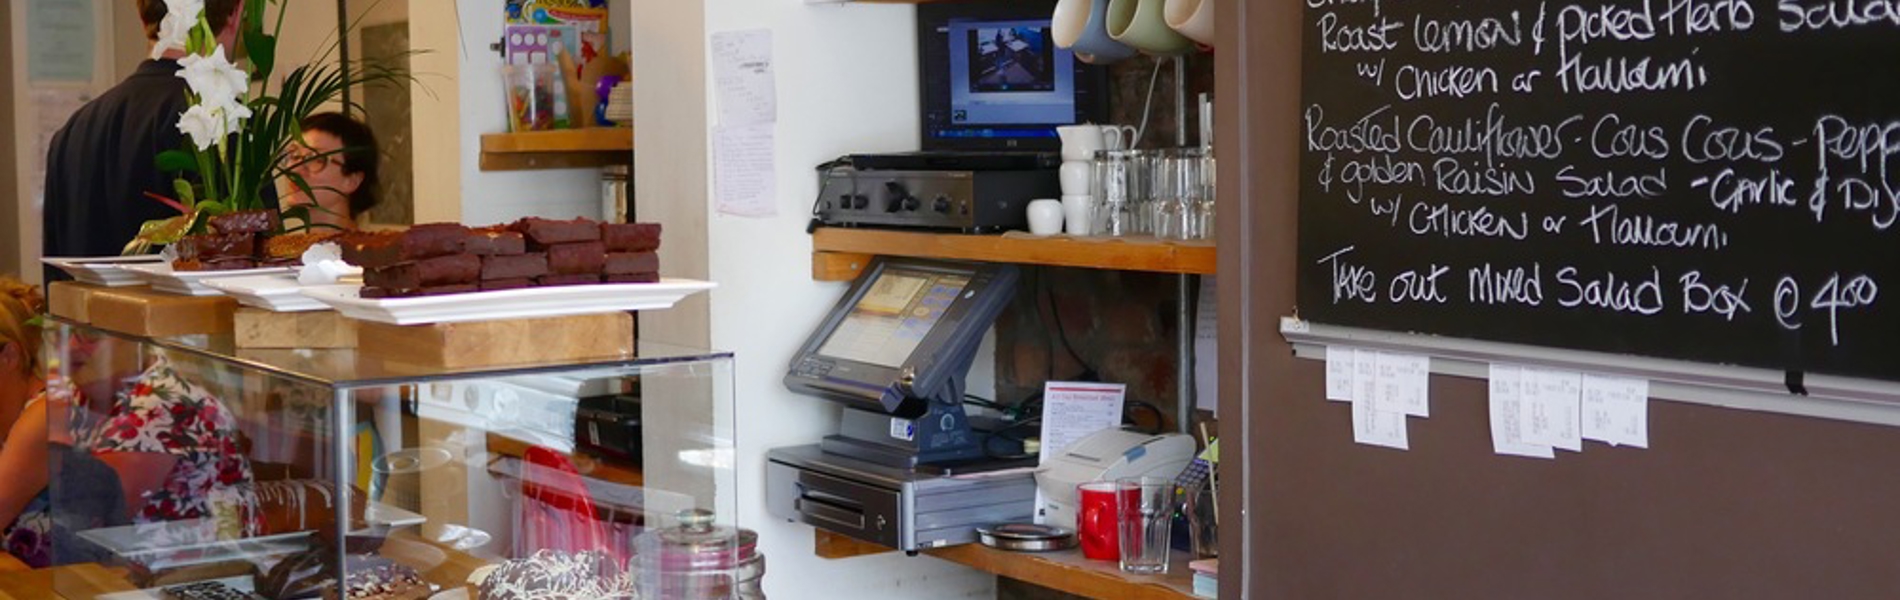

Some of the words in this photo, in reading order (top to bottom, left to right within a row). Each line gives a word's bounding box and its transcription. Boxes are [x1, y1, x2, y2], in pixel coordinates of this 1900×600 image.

[1317, 12, 1403, 52] Roast
[1533, 1, 1545, 55] &
[1659, 0, 1754, 35] Herb
[1357, 58, 1385, 86] w/
[1395, 65, 1498, 100] Chicken
[1305, 103, 1401, 152] Roasted
[1592, 113, 1669, 158] Cous
[1682, 114, 1783, 163] Cous
[1555, 165, 1667, 197] Salad
[1371, 193, 1401, 227] w/
[1543, 215, 1567, 234] or
[1390, 263, 1450, 303] out
[1556, 265, 1663, 315] Salad
[1679, 270, 1751, 320] Box
[1774, 276, 1802, 330] @
